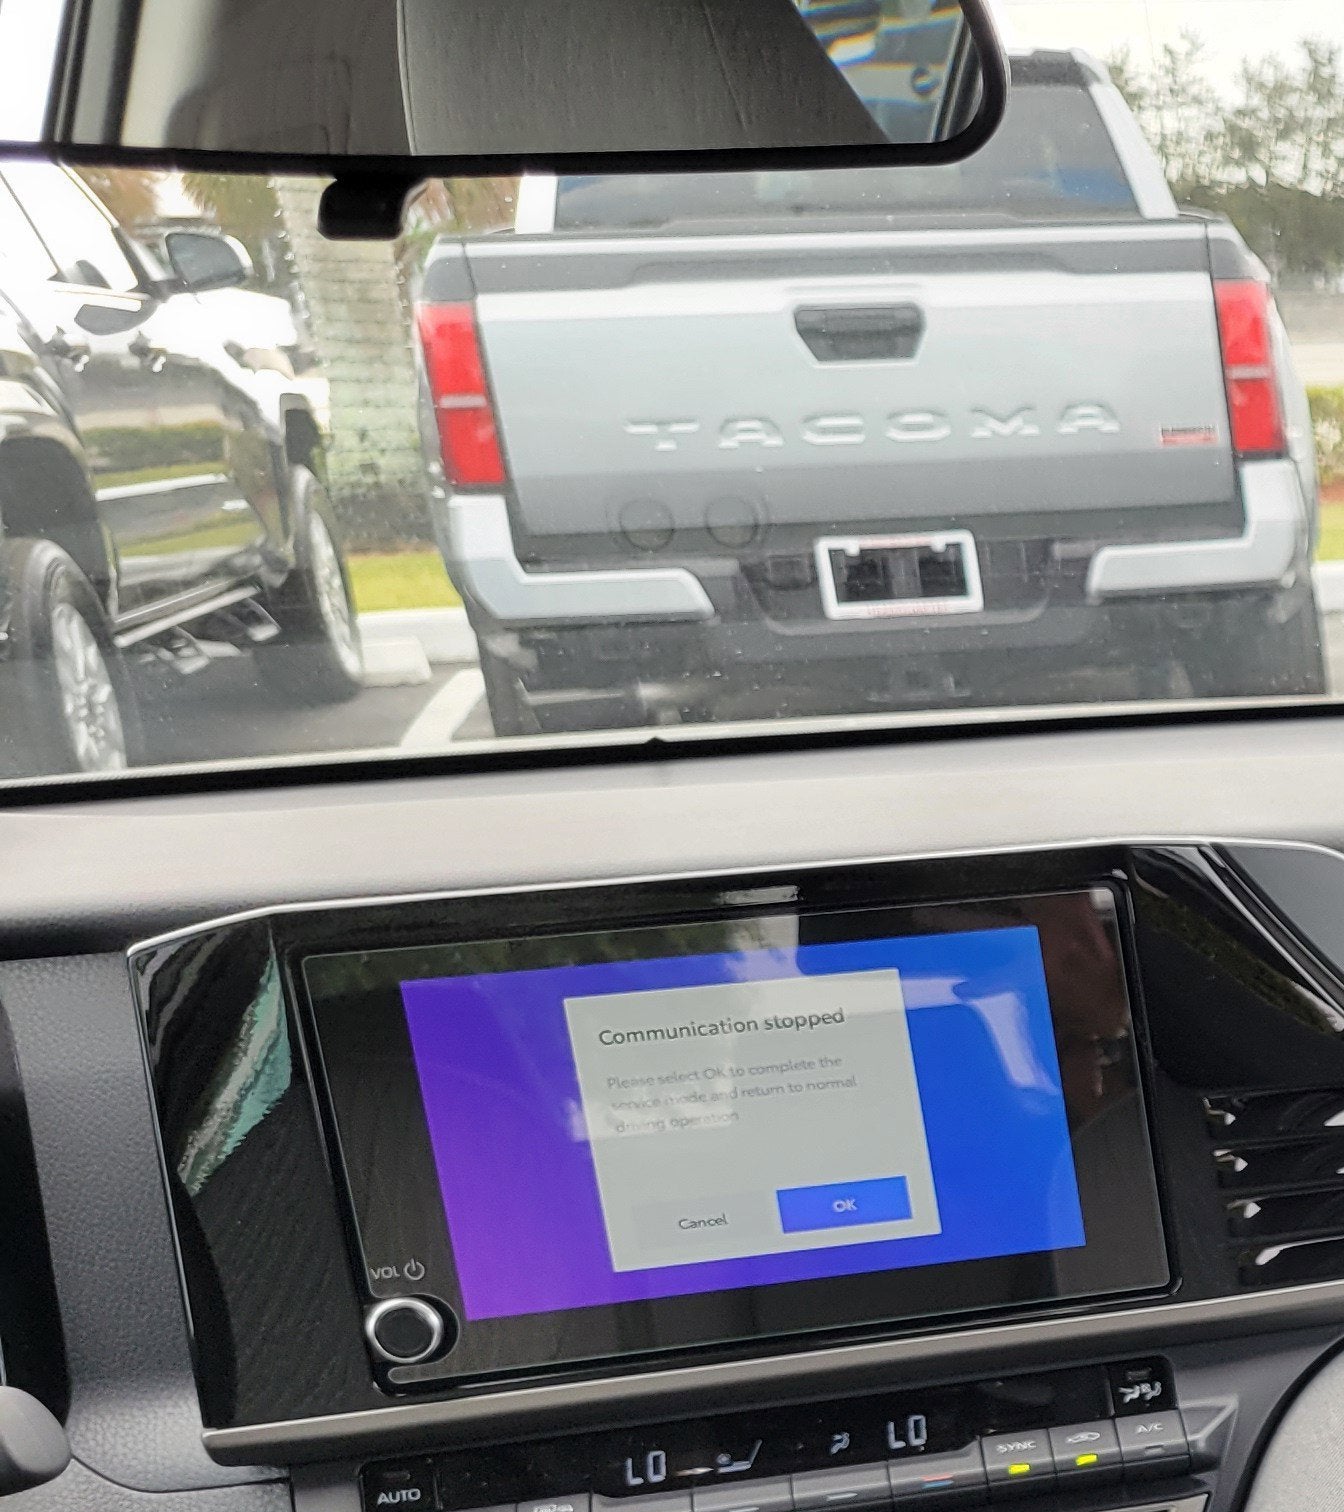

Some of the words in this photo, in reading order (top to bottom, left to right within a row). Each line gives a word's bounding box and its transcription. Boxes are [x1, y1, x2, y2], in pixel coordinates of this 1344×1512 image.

[622, 400, 1122, 452] TACOMA
[599, 1016, 759, 1046] Communication
[764, 1007, 845, 1033] stopped
[607, 1073, 656, 1090] Please
[657, 1069, 700, 1085] select
[729, 1066, 744, 1078] to
[748, 1057, 815, 1076] complete
[819, 1055, 843, 1068] the
[711, 1086, 739, 1101] and
[741, 1084, 786, 1097] return
[788, 1081, 804, 1094] to
[806, 1075, 858, 1091] normal
[832, 1199, 858, 1213] OK
[678, 1213, 729, 1231] Cancel
[371, 1266, 400, 1281] VOL
[1135, 1421, 1164, 1434] A/C
[997, 1438, 1038, 1453] SYNC
[376, 1487, 422, 1506] AUTO
